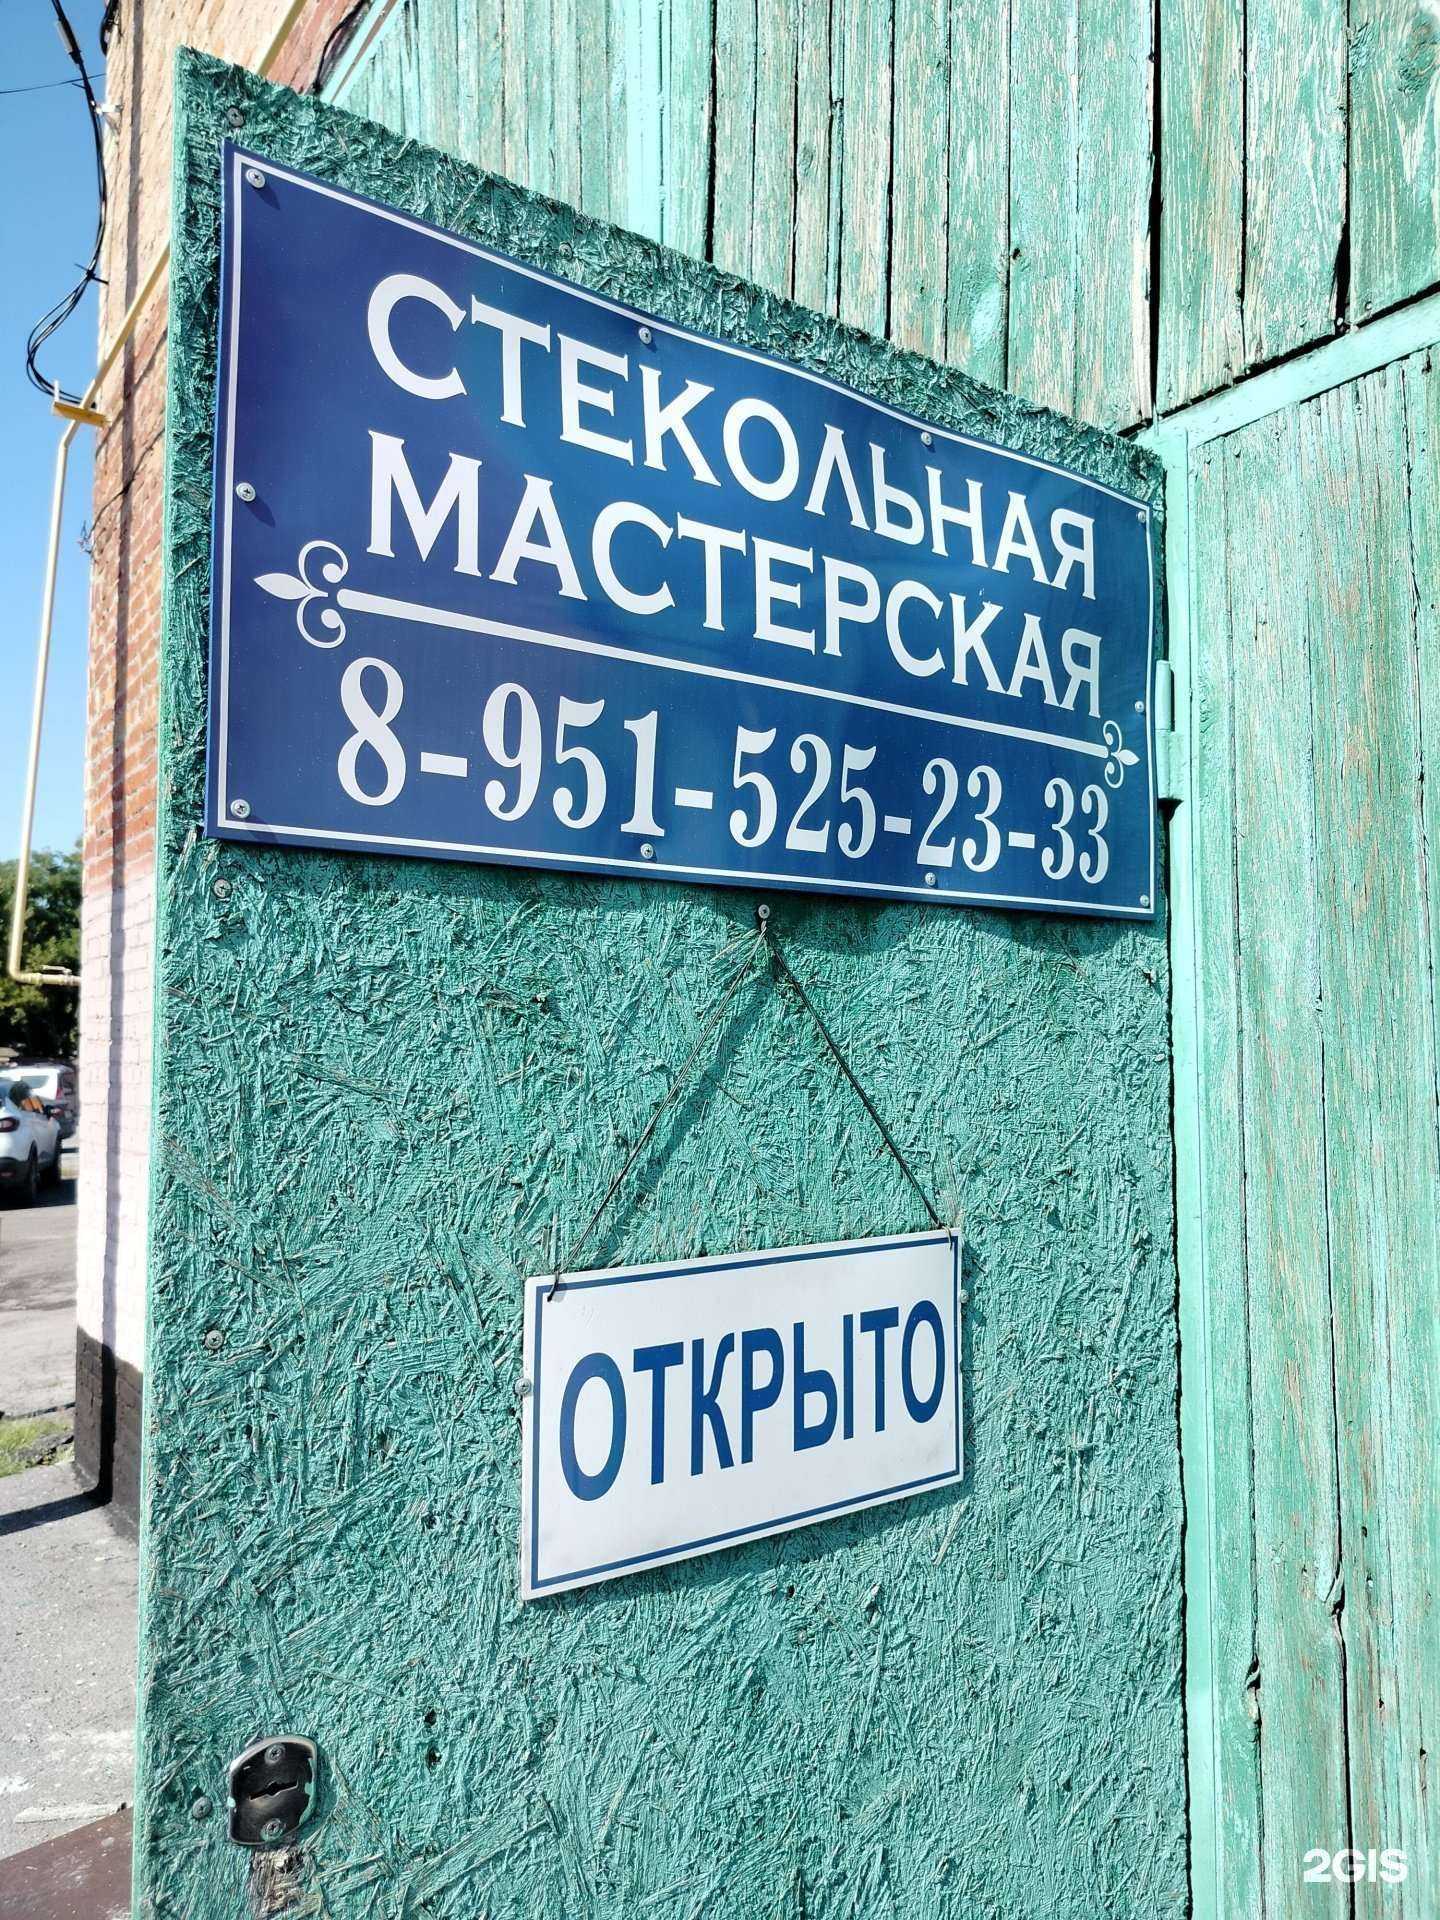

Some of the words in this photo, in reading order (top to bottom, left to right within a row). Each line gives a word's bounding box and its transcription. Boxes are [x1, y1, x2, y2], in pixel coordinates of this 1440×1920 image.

[367, 273, 1096, 600] СТЕКОЛЬНАЯ
[366, 430, 1103, 717] МАСТЕРСКАЯ
[337, 656, 1111, 885] 8-951-525-23-33
[559, 1299, 946, 1502] ОТКРЫТО
